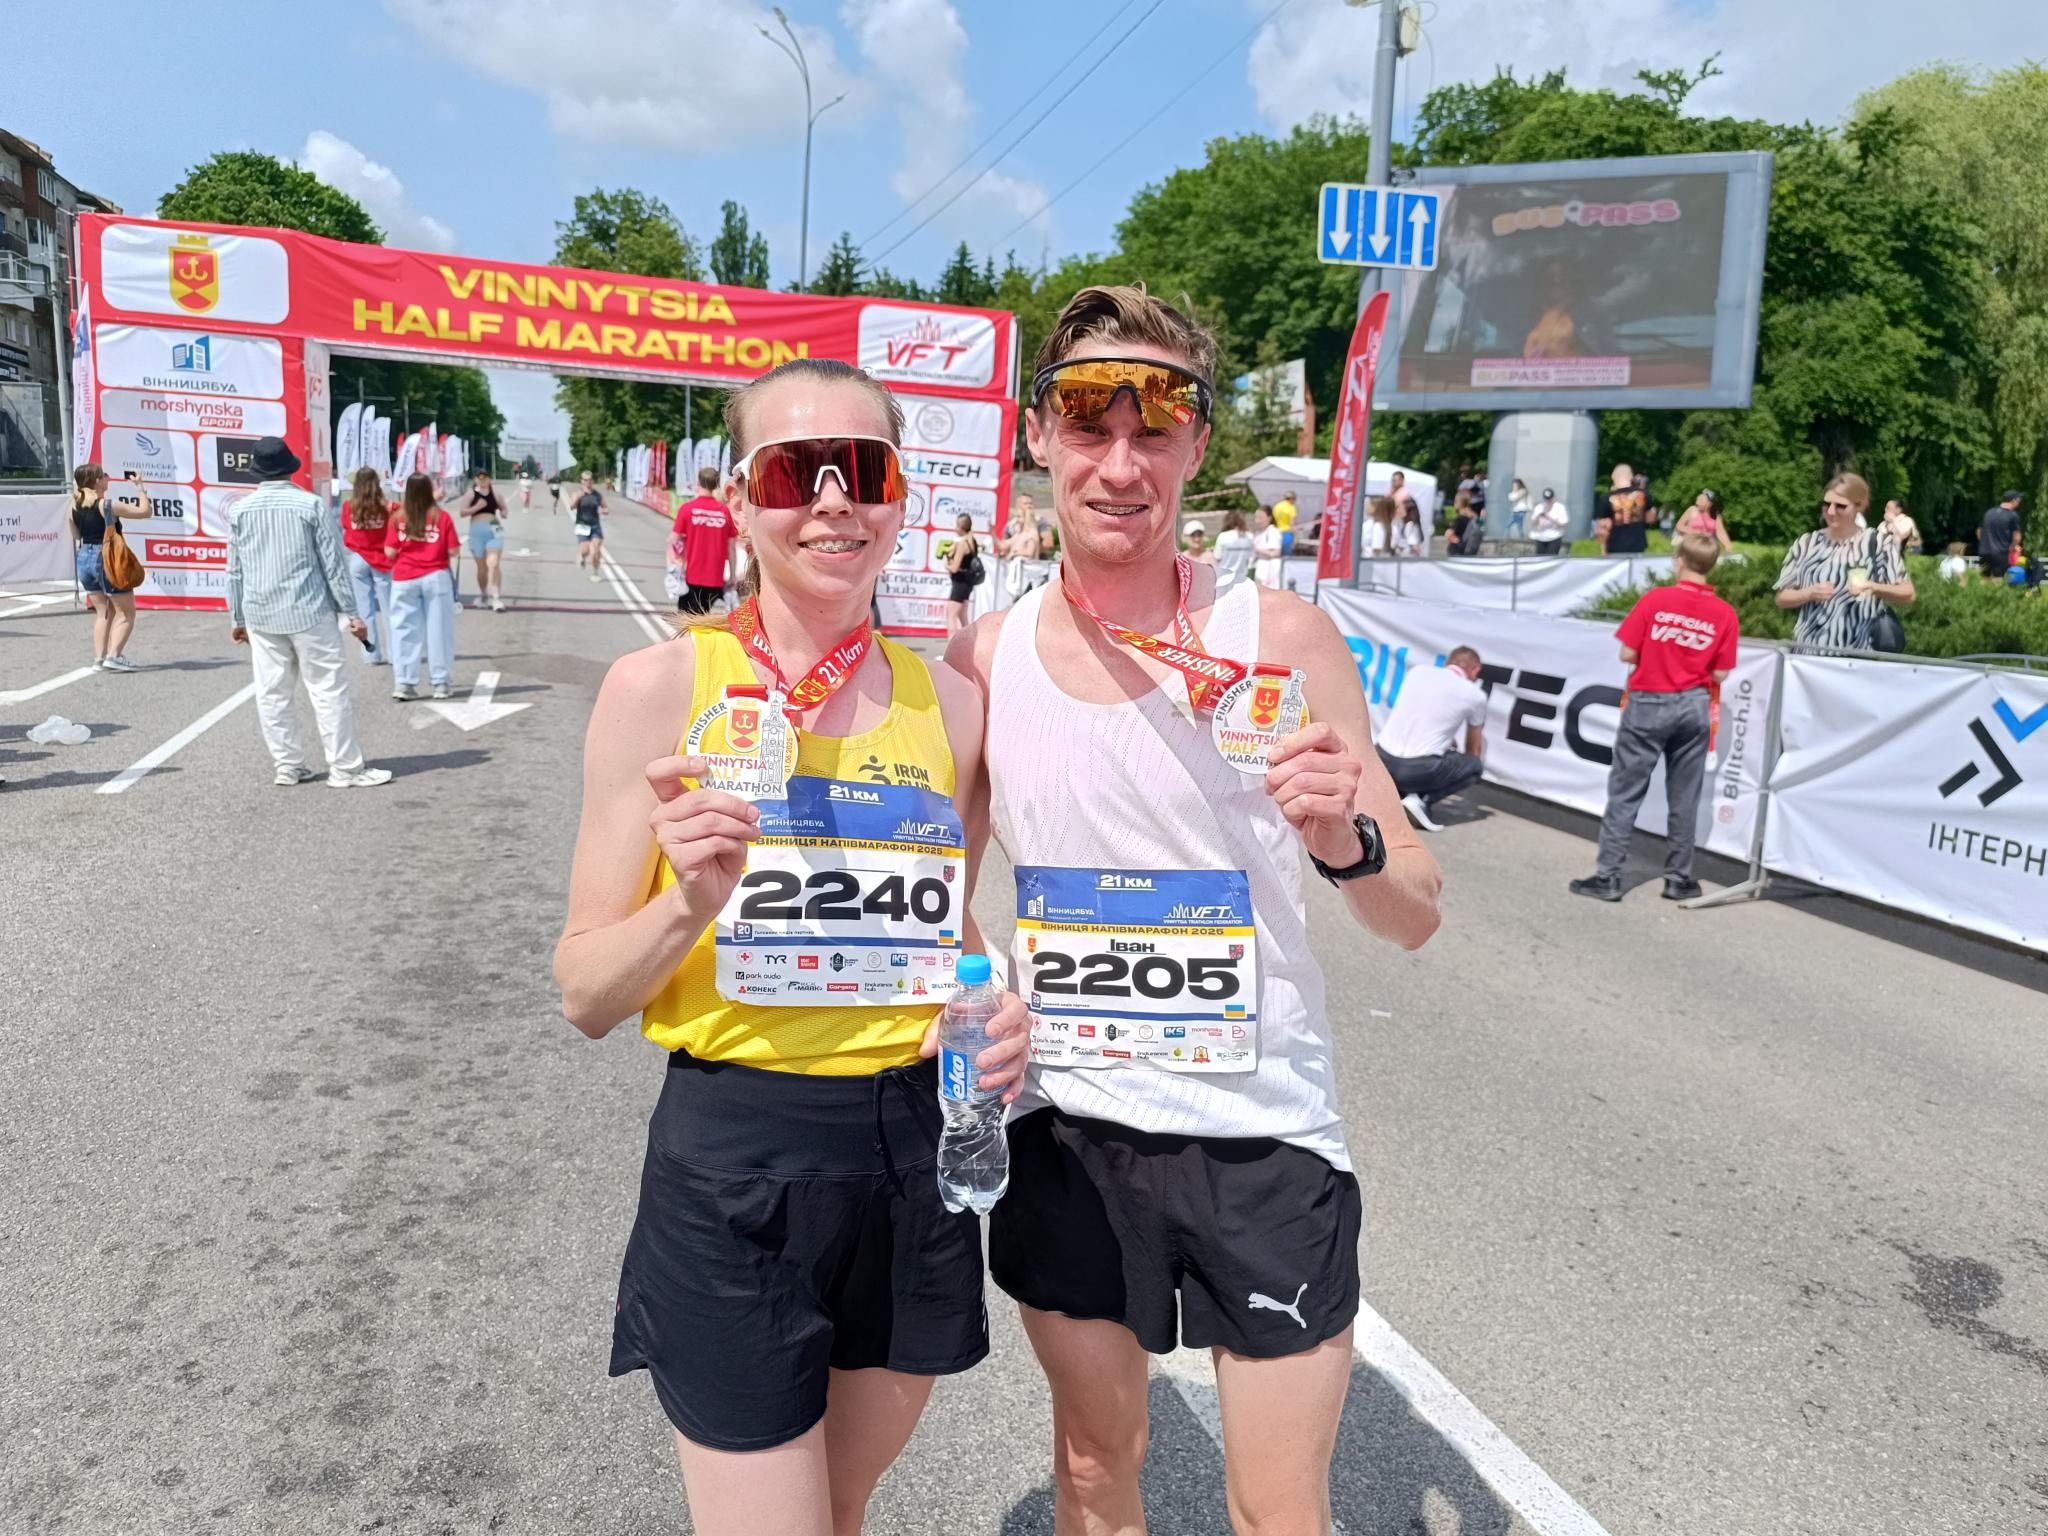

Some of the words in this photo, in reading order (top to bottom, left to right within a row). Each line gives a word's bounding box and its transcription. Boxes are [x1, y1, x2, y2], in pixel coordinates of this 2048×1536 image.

[438, 265, 736, 325] VINNYTSIA
[353, 299, 503, 342] HALF
[516, 318, 808, 368] MARATHON
[886, 341, 968, 371] VFT
[141, 399, 243, 417] morshynska
[201, 418, 241, 427] SPORT
[1654, 611, 1716, 636] OFFICIAL
[818, 641, 864, 685] 21.1km
[1215, 680, 1254, 721] FINISHER
[688, 702, 728, 746] FINISHER
[1221, 740, 1259, 754] HALF
[1723, 680, 1752, 800] Billtech.io
[785, 737, 793, 773] 01.06.2025
[713, 767, 741, 781] ALF
[893, 763, 930, 783] IRON
[705, 780, 782, 794] MARATHON
[829, 784, 852, 799] 21
[917, 822, 948, 837] VFT
[757, 837, 817, 847] ВІННИЦЯ
[820, 839, 915, 852] НАПІВМАРАФОН
[917, 845, 943, 855] 2025
[1929, 822, 2048, 877] ІНТЕРН
[1100, 874, 1122, 888] 21
[740, 870, 950, 924] 2240
[1191, 905, 1232, 918] VFT
[737, 925, 751, 935] 20
[1041, 922, 1088, 932] ВІННИЦЯ
[1091, 925, 1188, 935] НАПІВМАРАФОН
[1110, 939, 1155, 953] Іван
[764, 955, 787, 964] TYR
[891, 954, 907, 963] IKS
[745, 972, 762, 980] park
[1032, 951, 1240, 1000] 2205
[1050, 1022, 1069, 1031] TYR
[1165, 1027, 1184, 1036] IKS
[948, 1054, 965, 1100] eko
